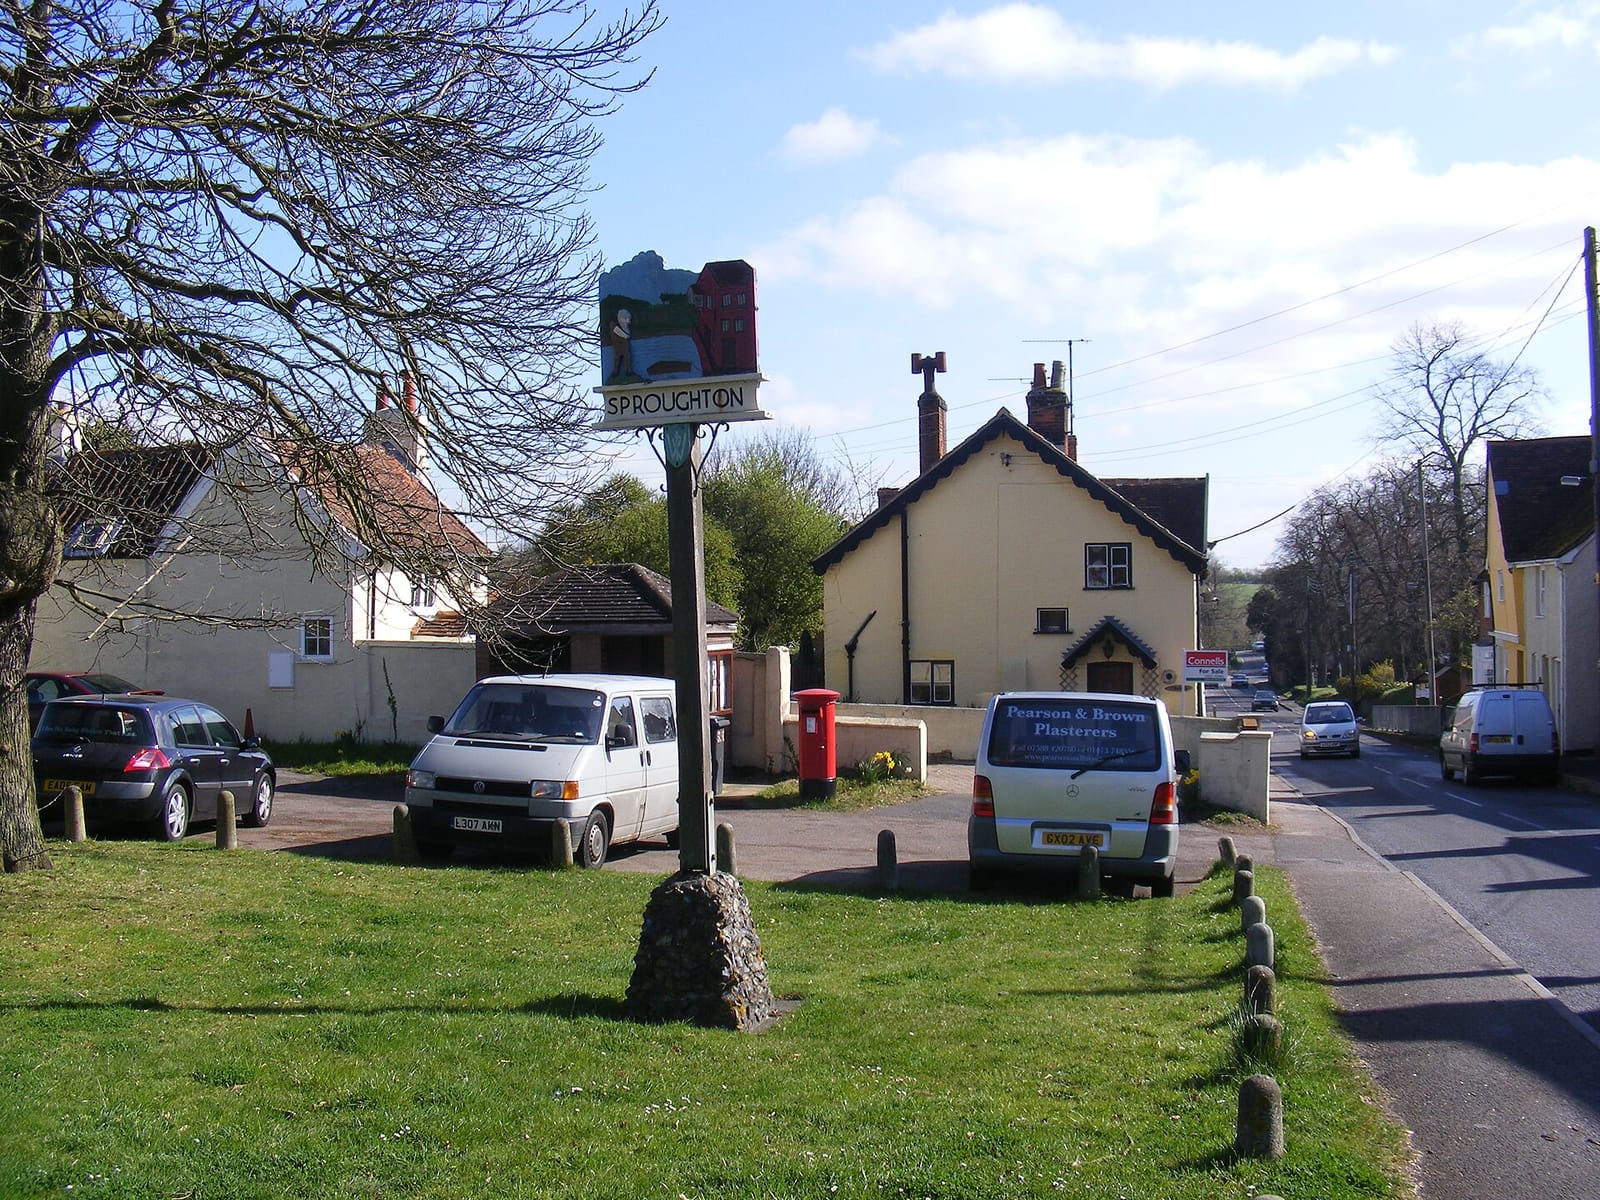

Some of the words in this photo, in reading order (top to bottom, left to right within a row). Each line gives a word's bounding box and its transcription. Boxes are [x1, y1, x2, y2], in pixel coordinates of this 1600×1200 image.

[607, 386, 744, 415] SPROUGHTON
[1188, 657, 1225, 665] Connells
[1006, 705, 1071, 720] Pearson
[1075, 707, 1088, 720] &
[1092, 708, 1146, 722] Brown
[1034, 723, 1118, 738] Plasterers
[1046, 833, 1076, 846] GX02
[1078, 834, 1100, 847] AVE
